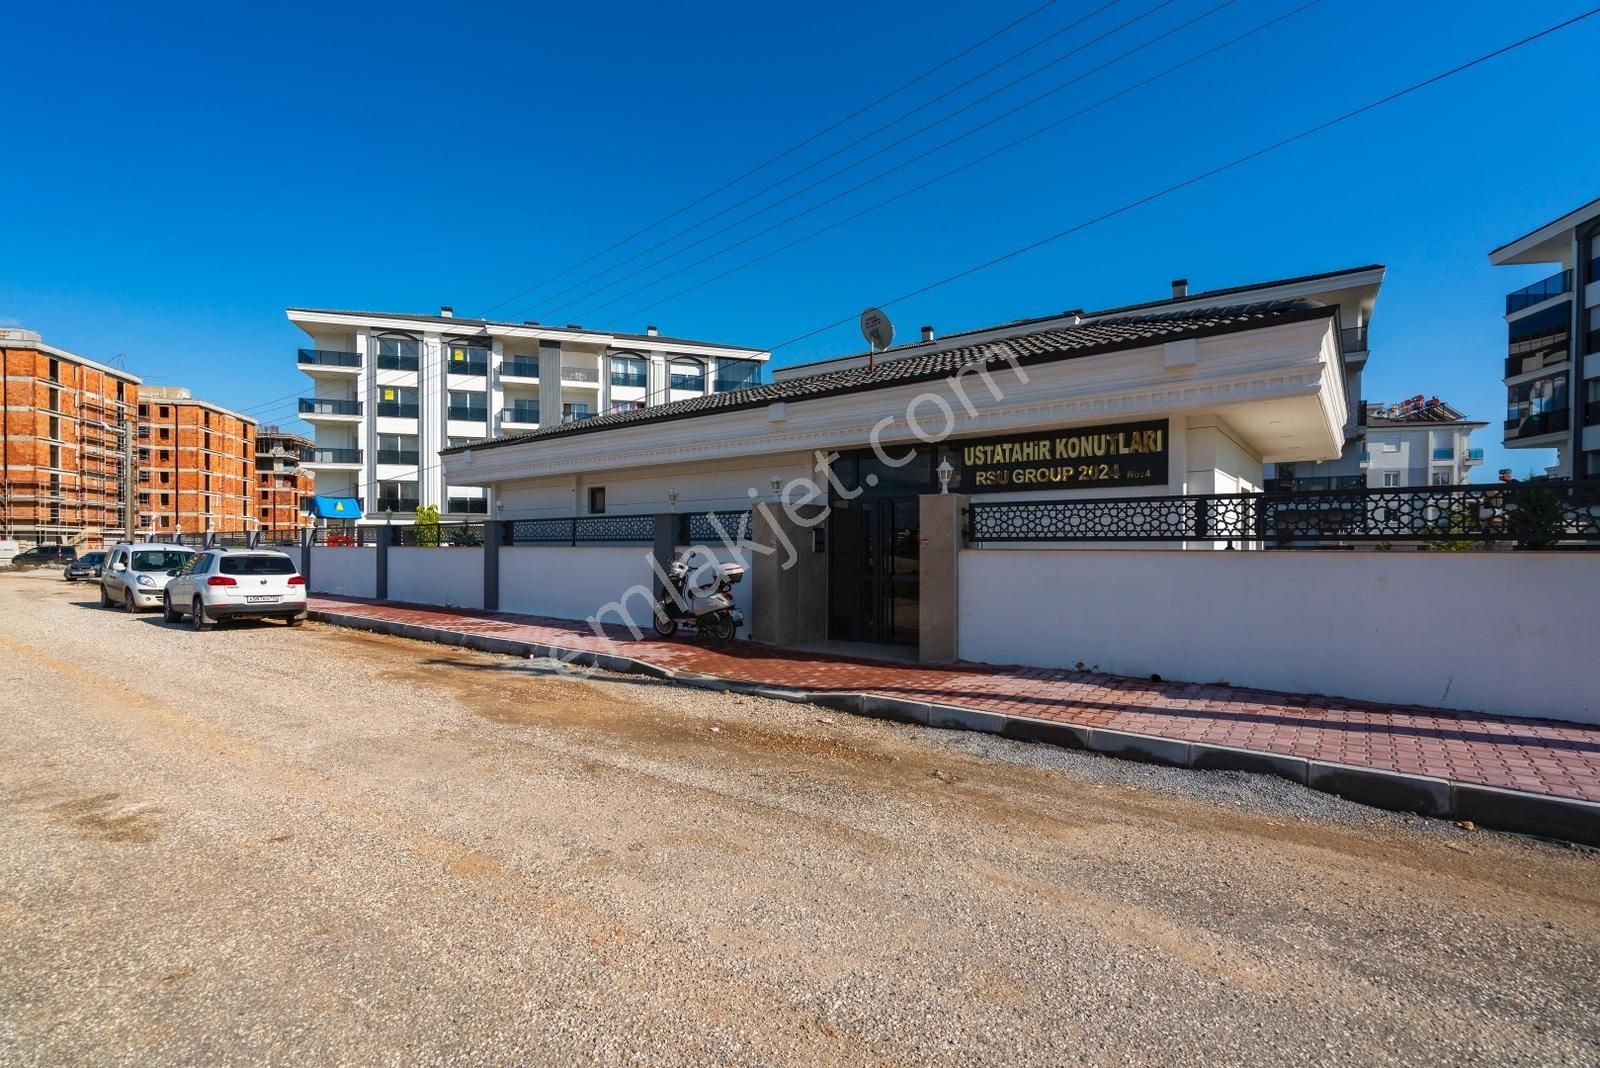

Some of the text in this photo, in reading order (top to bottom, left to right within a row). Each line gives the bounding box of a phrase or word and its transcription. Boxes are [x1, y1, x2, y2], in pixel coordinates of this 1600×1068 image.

[1055, 430, 1163, 459] KONUTLARI
[975, 471, 1009, 486] RSU
[1012, 466, 1074, 484] GROUP
